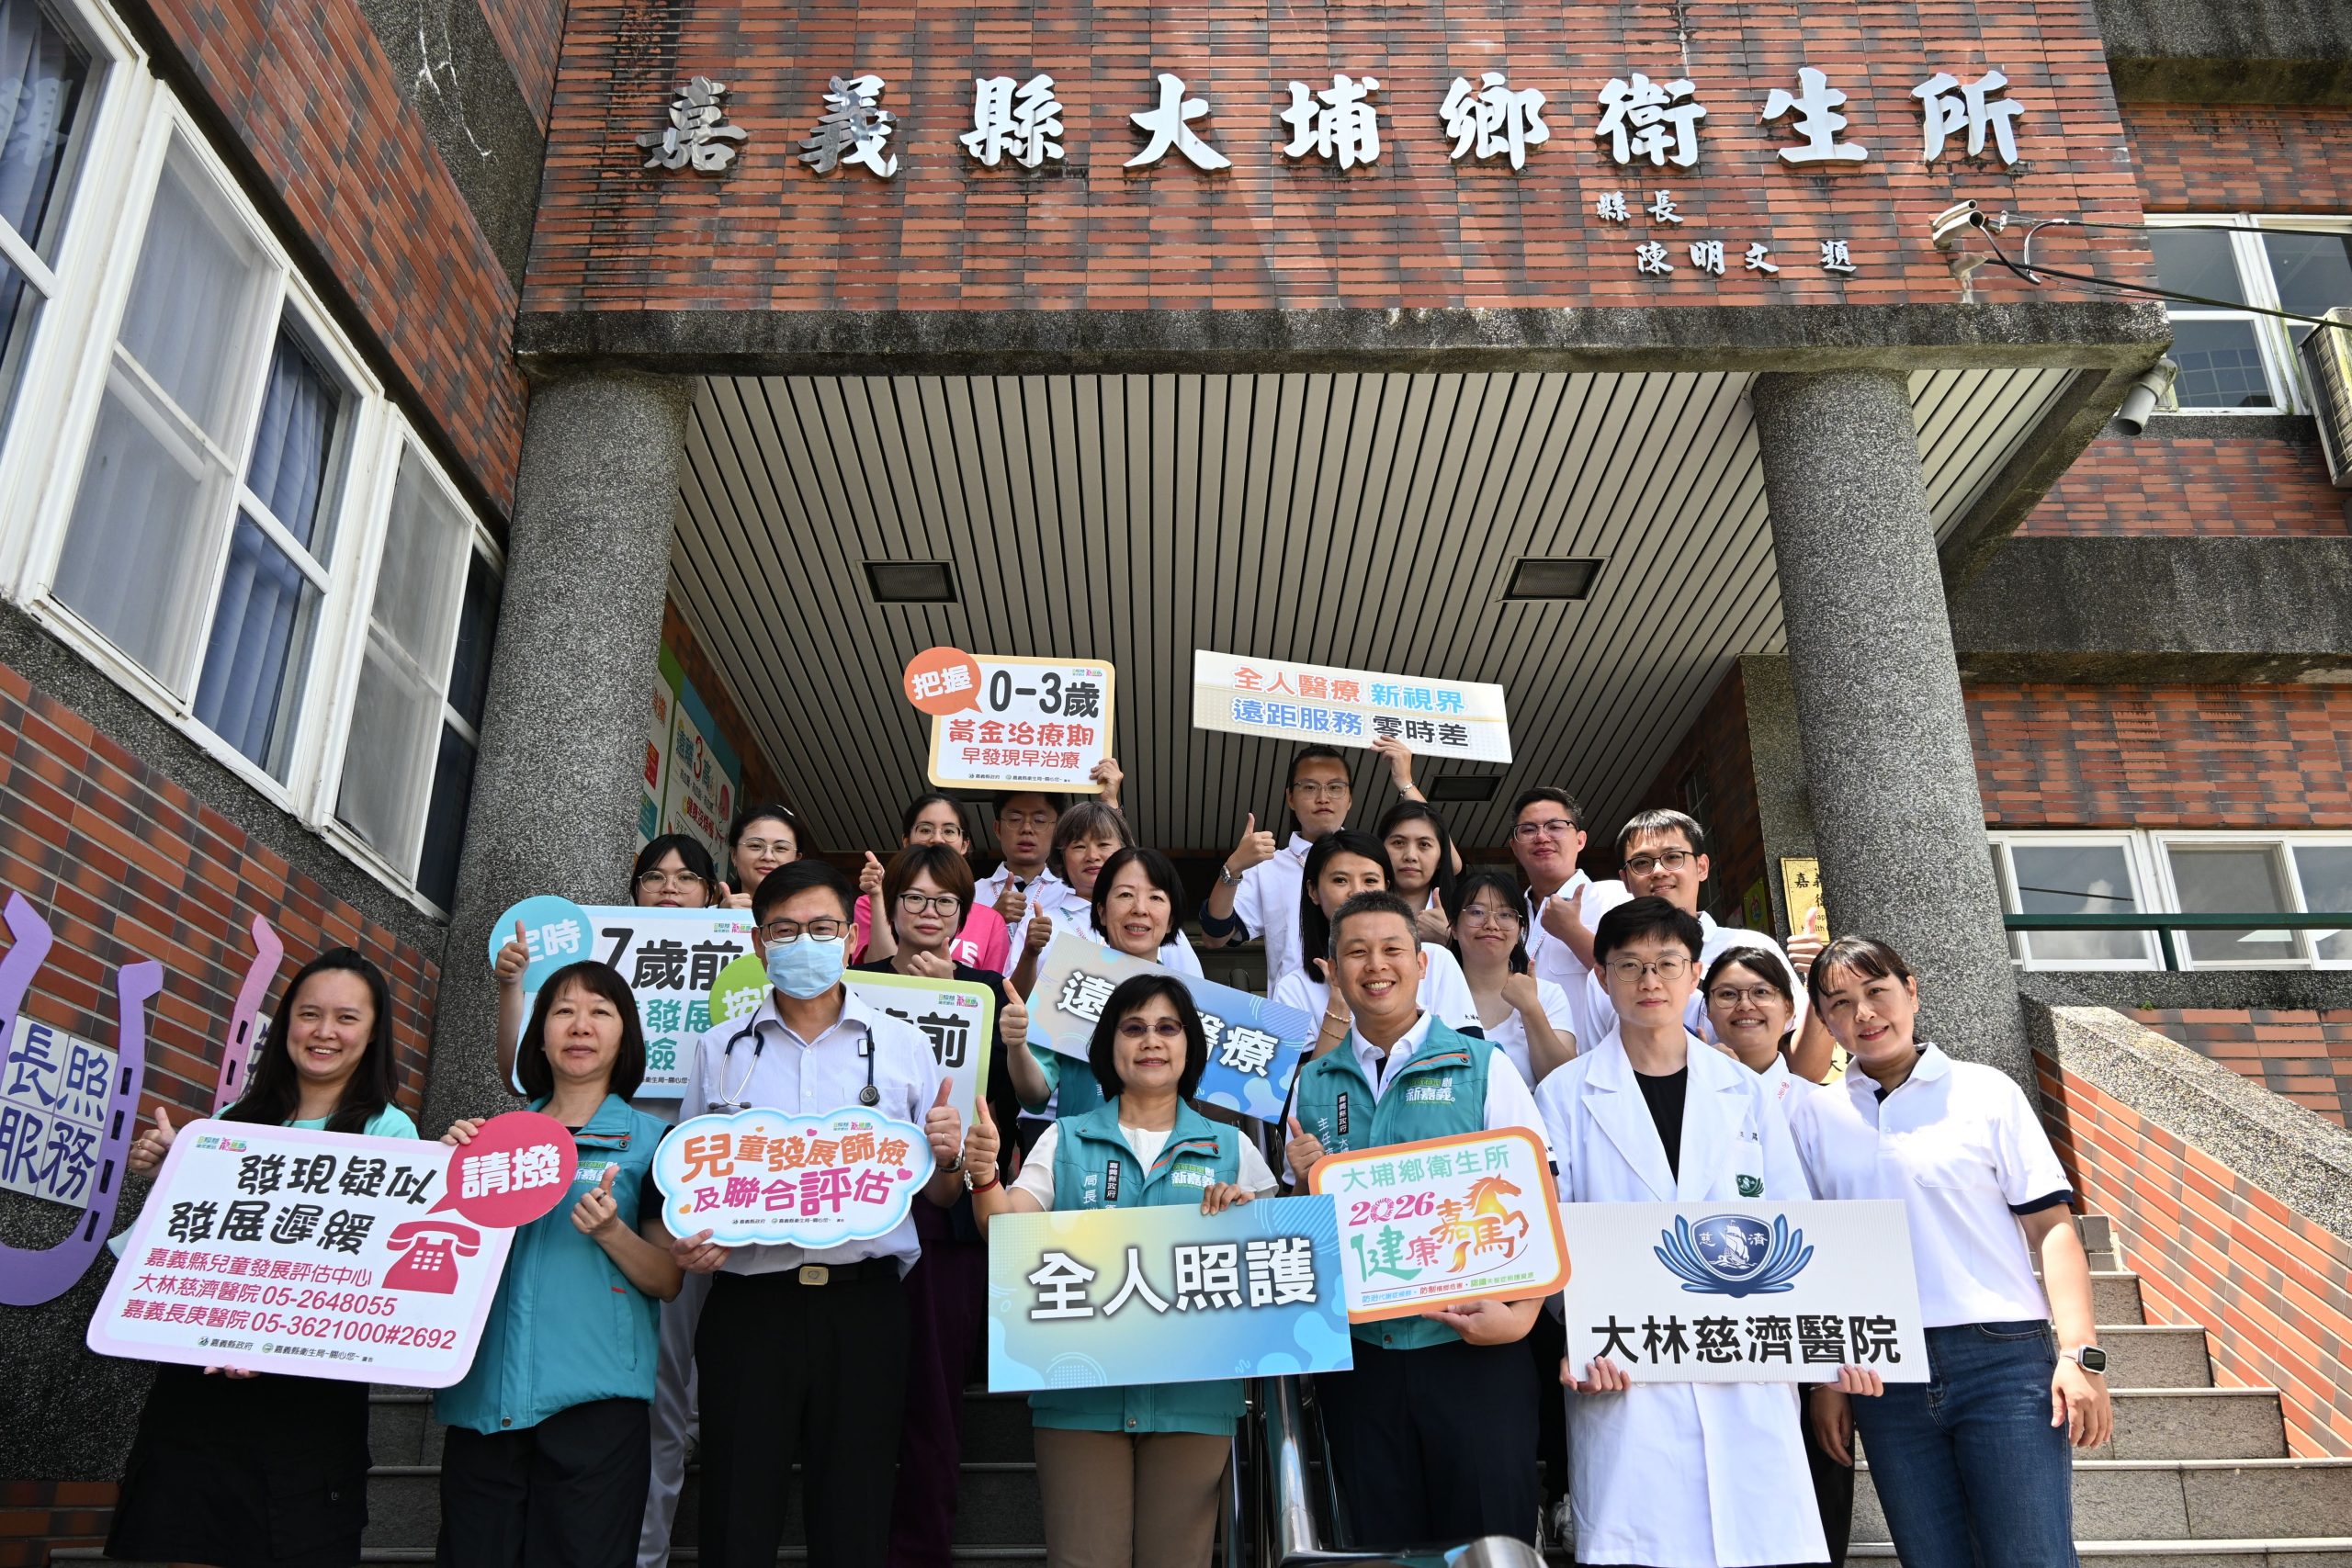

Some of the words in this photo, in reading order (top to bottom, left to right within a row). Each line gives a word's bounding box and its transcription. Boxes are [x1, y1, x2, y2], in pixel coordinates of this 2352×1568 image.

[636, 67, 2025, 178] 嘉義縣大埔鄉衛生所
[1596, 190, 1683, 223] 縣長
[911, 664, 973, 700] 把握
[989, 670, 1100, 719] 0-3歲
[1234, 667, 1360, 703] 全人醫療
[1371, 682, 1464, 714] 新視界
[949, 718, 1094, 747] 黃金治療期
[1233, 698, 1363, 736] 遠距服務
[1373, 715, 1469, 747] 零時差
[961, 747, 1080, 770] 早發現早治療
[600, 927, 743, 992] 7歲前
[635, 998, 713, 1033] 發展
[8, 1023, 108, 1122] 長照
[0, 1108, 96, 1201] 服務
[238, 1154, 437, 1204] 發現疑似
[460, 1143, 561, 1200] 請撥
[1341, 1145, 1510, 1192] 大埔鄉衛生所
[694, 1167, 894, 1217] 及聯合評估
[1083, 1174, 1098, 1210] 局長
[167, 1200, 376, 1256] 發展遲緩
[144, 1247, 373, 1287] 嘉義縣兒童發展評估中心
[1028, 1237, 1317, 1319] 全人照護
[132, 1273, 259, 1303] 大林慈濟醫院
[262, 1285, 398, 1317] 05-2648055
[120, 1298, 250, 1331] 嘉義長庚醫院
[251, 1312, 458, 1350] 05-3621000#2692
[1590, 1314, 1902, 1365] 大林慈濟醫院
